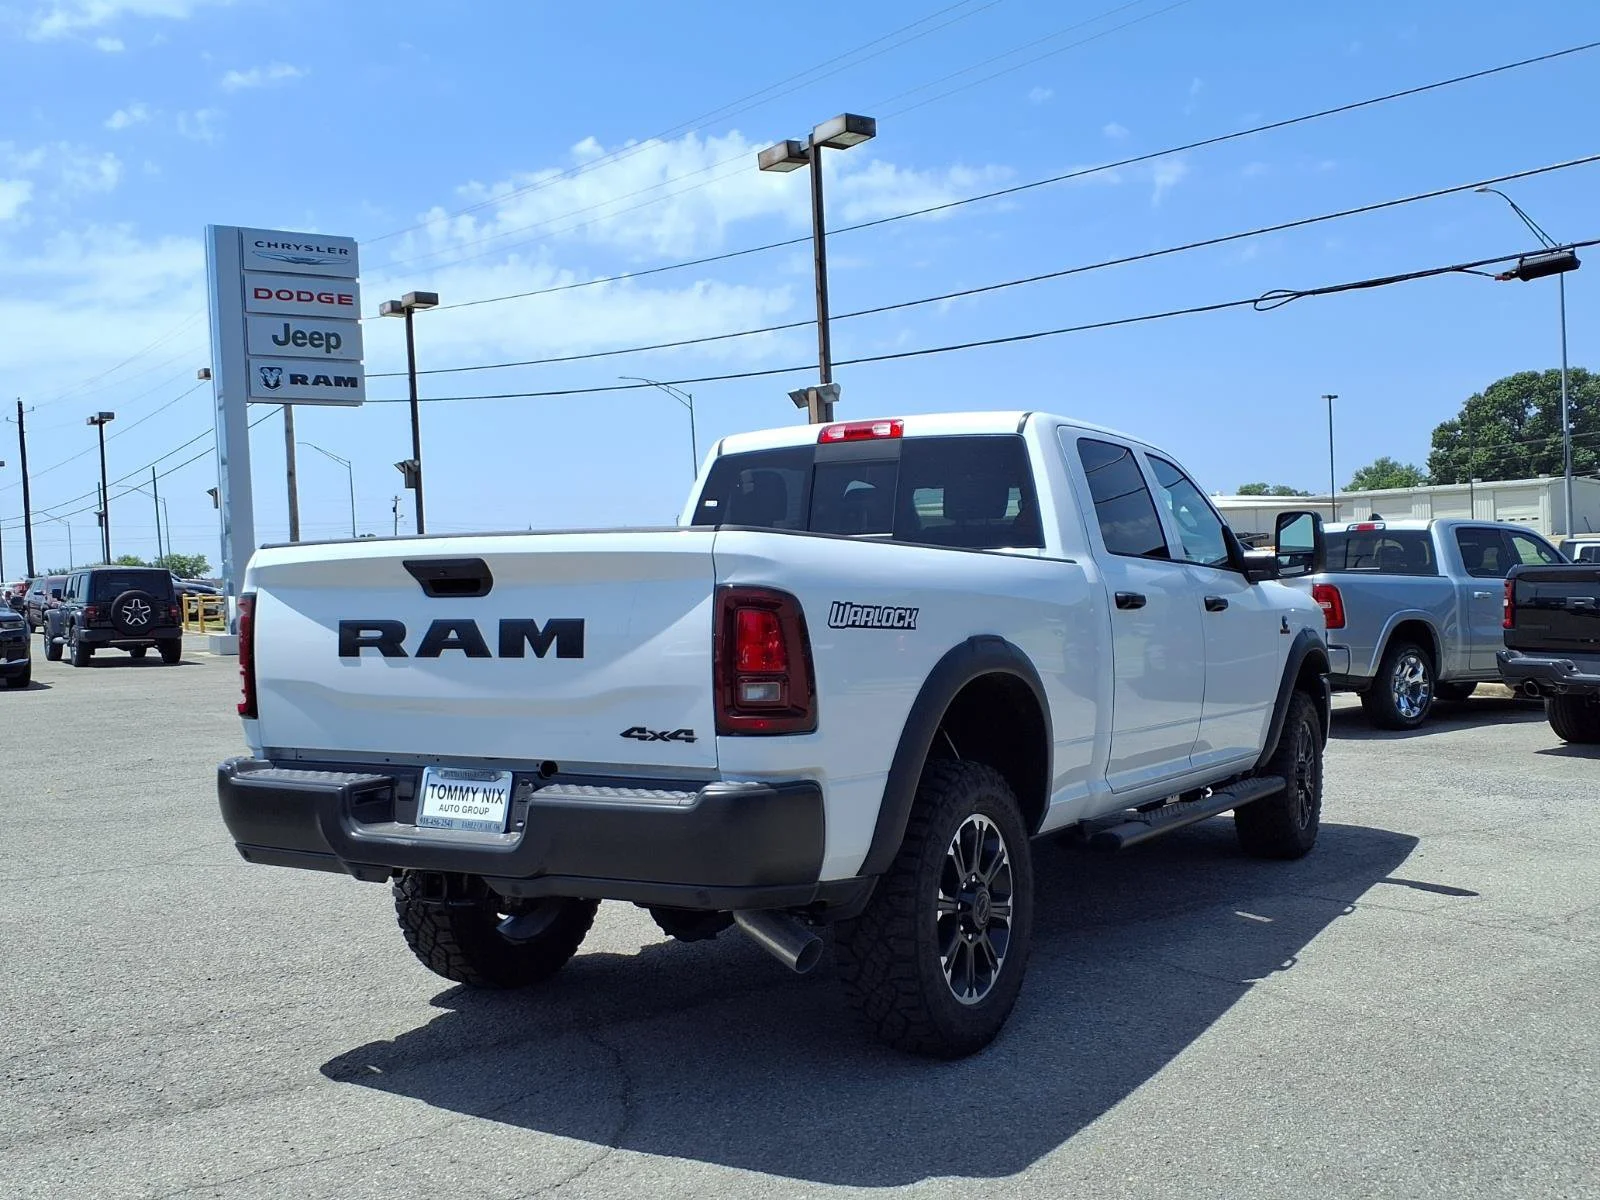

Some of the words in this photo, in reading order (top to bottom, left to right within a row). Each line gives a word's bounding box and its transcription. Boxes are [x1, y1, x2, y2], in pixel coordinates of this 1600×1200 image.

[254, 240, 349, 256] CHRYSLER
[254, 287, 354, 306] DODGE
[271, 322, 342, 354] Jeep
[289, 373, 358, 388] RAM
[338, 618, 585, 659] RAM
[429, 783, 480, 803] TOMMY
[481, 786, 506, 805] NIX
[438, 803, 461, 814] AUTO
[461, 805, 490, 816] GROUP
